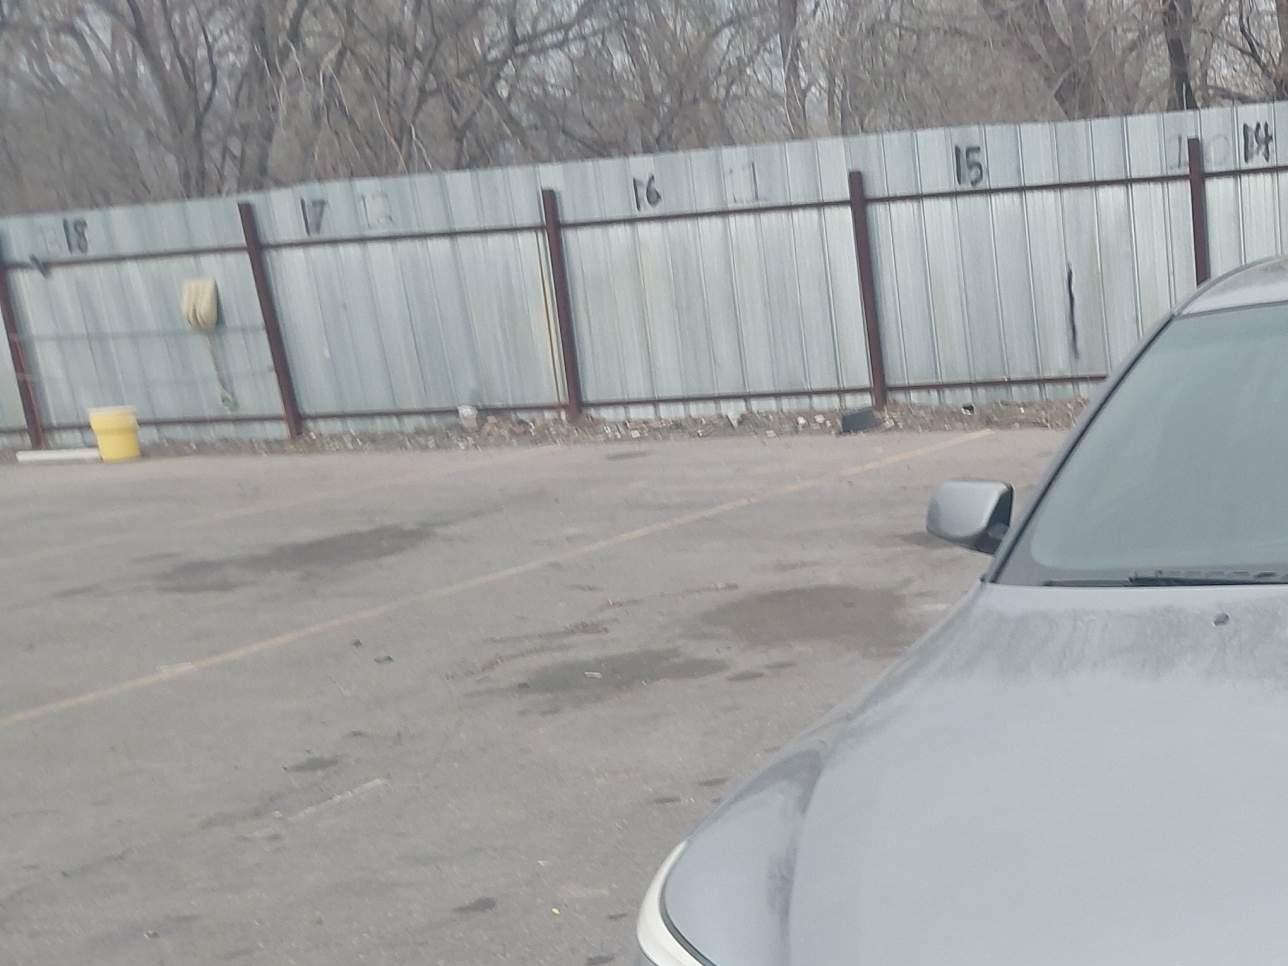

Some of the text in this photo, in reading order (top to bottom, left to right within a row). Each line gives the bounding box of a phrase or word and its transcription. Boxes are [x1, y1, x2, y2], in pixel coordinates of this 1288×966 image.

[1243, 121, 1273, 163] 14
[954, 145, 983, 187] 15
[632, 174, 662, 212] 16
[300, 197, 328, 236] 17
[62, 218, 88, 255] 18
